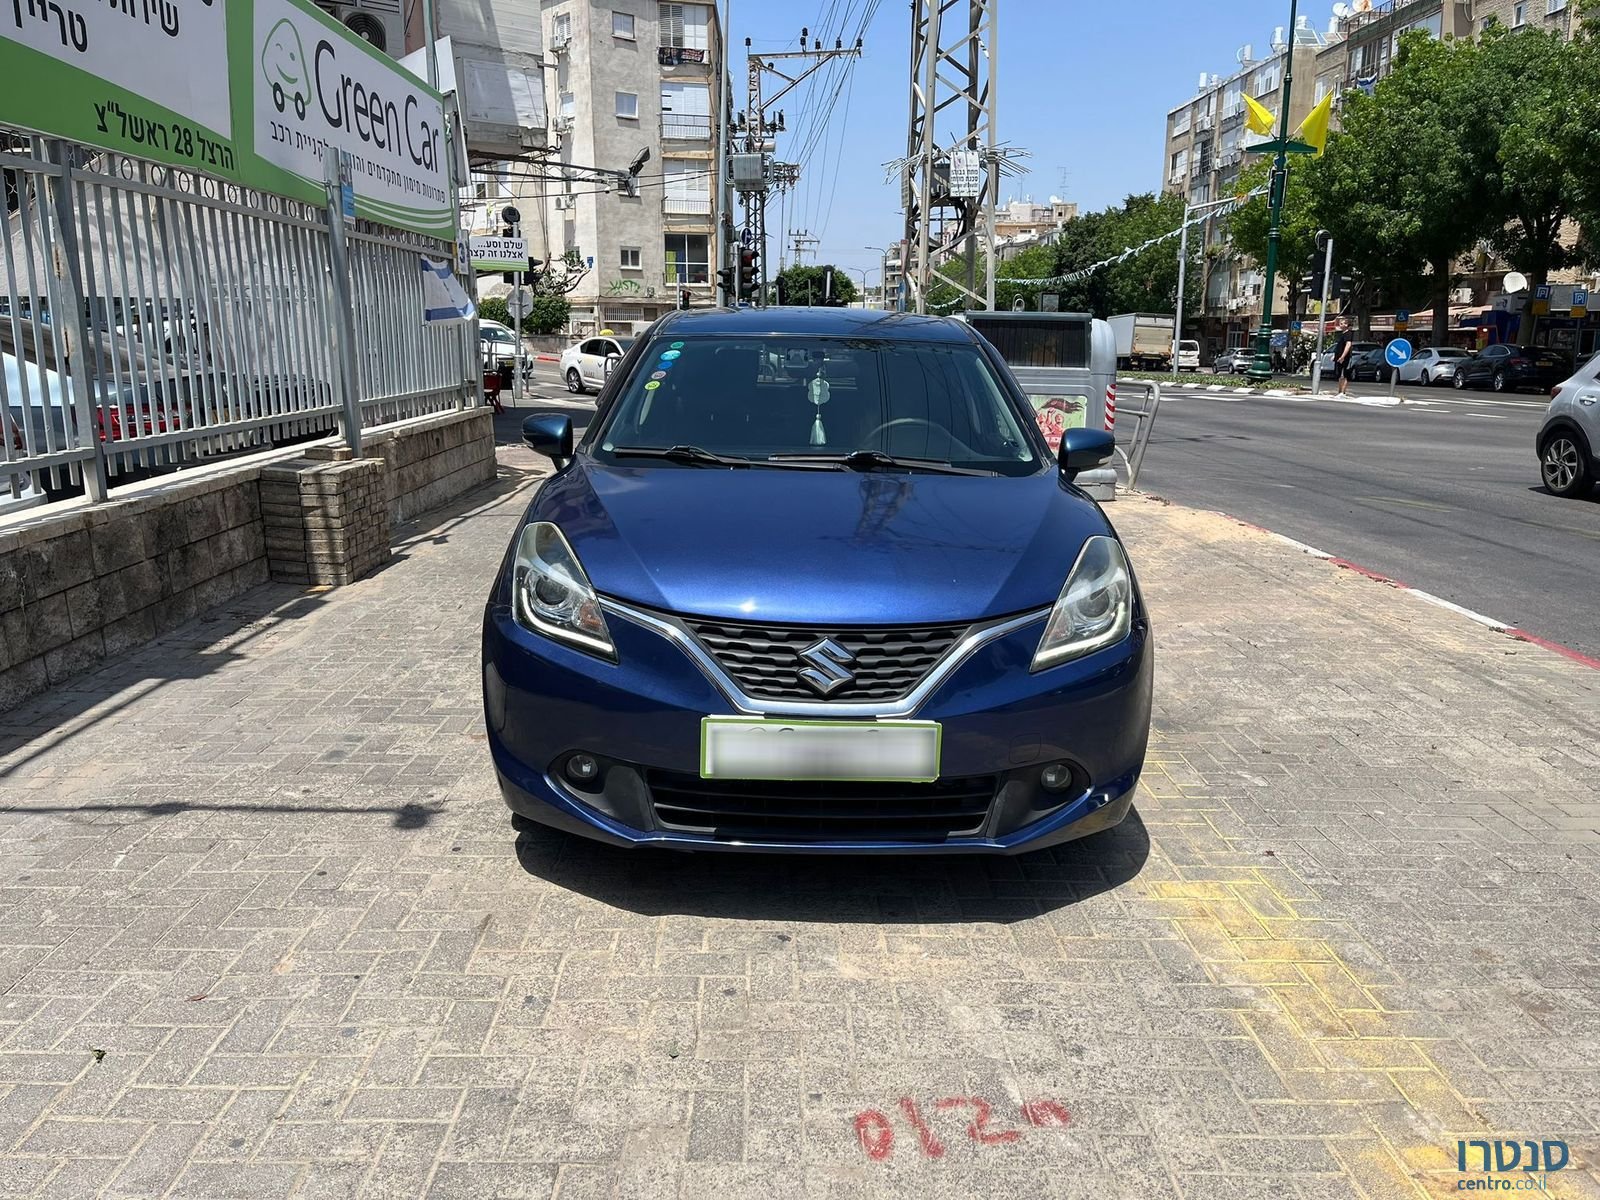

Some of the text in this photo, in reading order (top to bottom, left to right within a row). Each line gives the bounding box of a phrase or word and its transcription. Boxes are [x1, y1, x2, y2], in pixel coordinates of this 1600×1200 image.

[315, 39, 439, 174] Green Car
[172, 123, 194, 158] 28
[270, 120, 292, 146] רכב
[196, 130, 235, 171] הרצל
[367, 160, 402, 188] מתקדמים
[403, 174, 421, 194] מימון
[488, 250, 497, 258] זה
[500, 250, 524, 259] אצלנו
[504, 240, 523, 250] שלם
